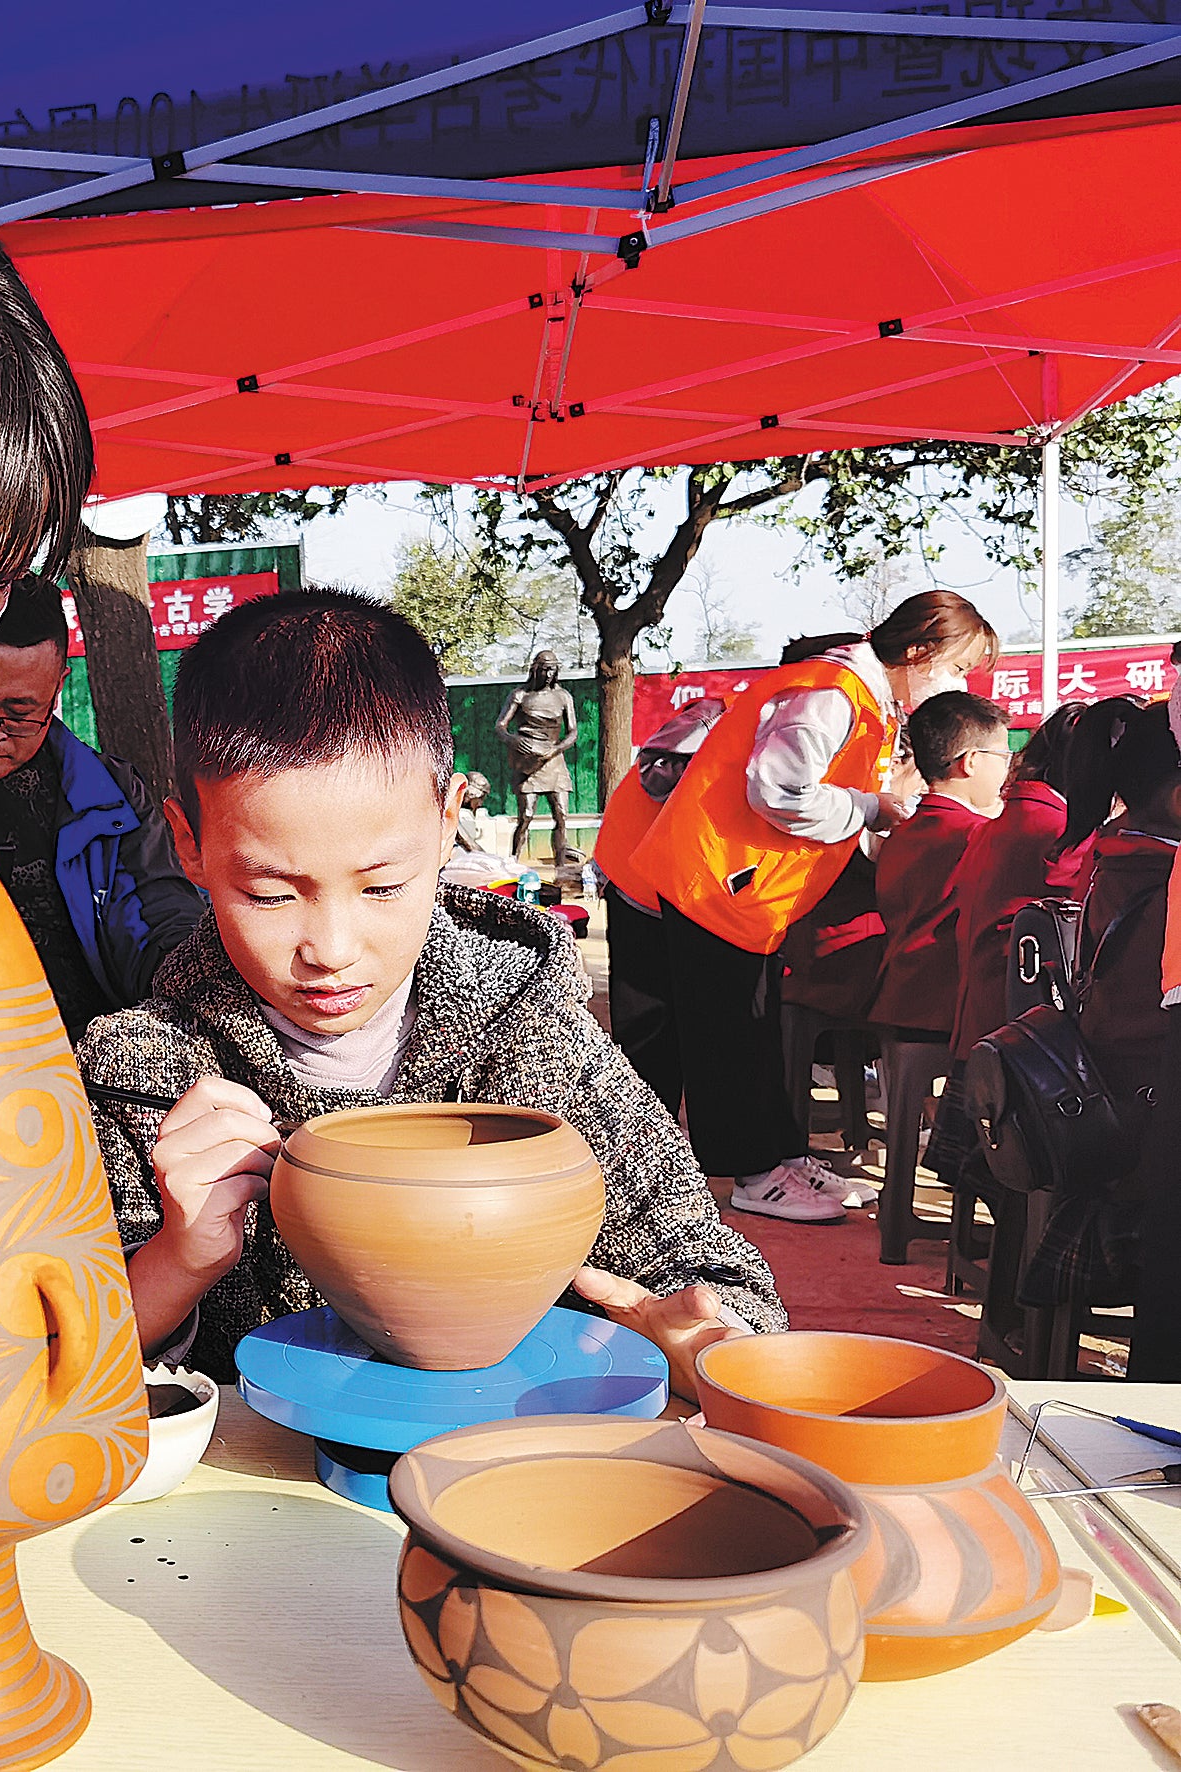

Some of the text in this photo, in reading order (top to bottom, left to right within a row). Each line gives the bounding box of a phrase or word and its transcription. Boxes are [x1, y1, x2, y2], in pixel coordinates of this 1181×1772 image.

[149, 587, 234, 622] 古学
[153, 620, 215, 637] 古研究
[990, 659, 1166, 700] 际大研
